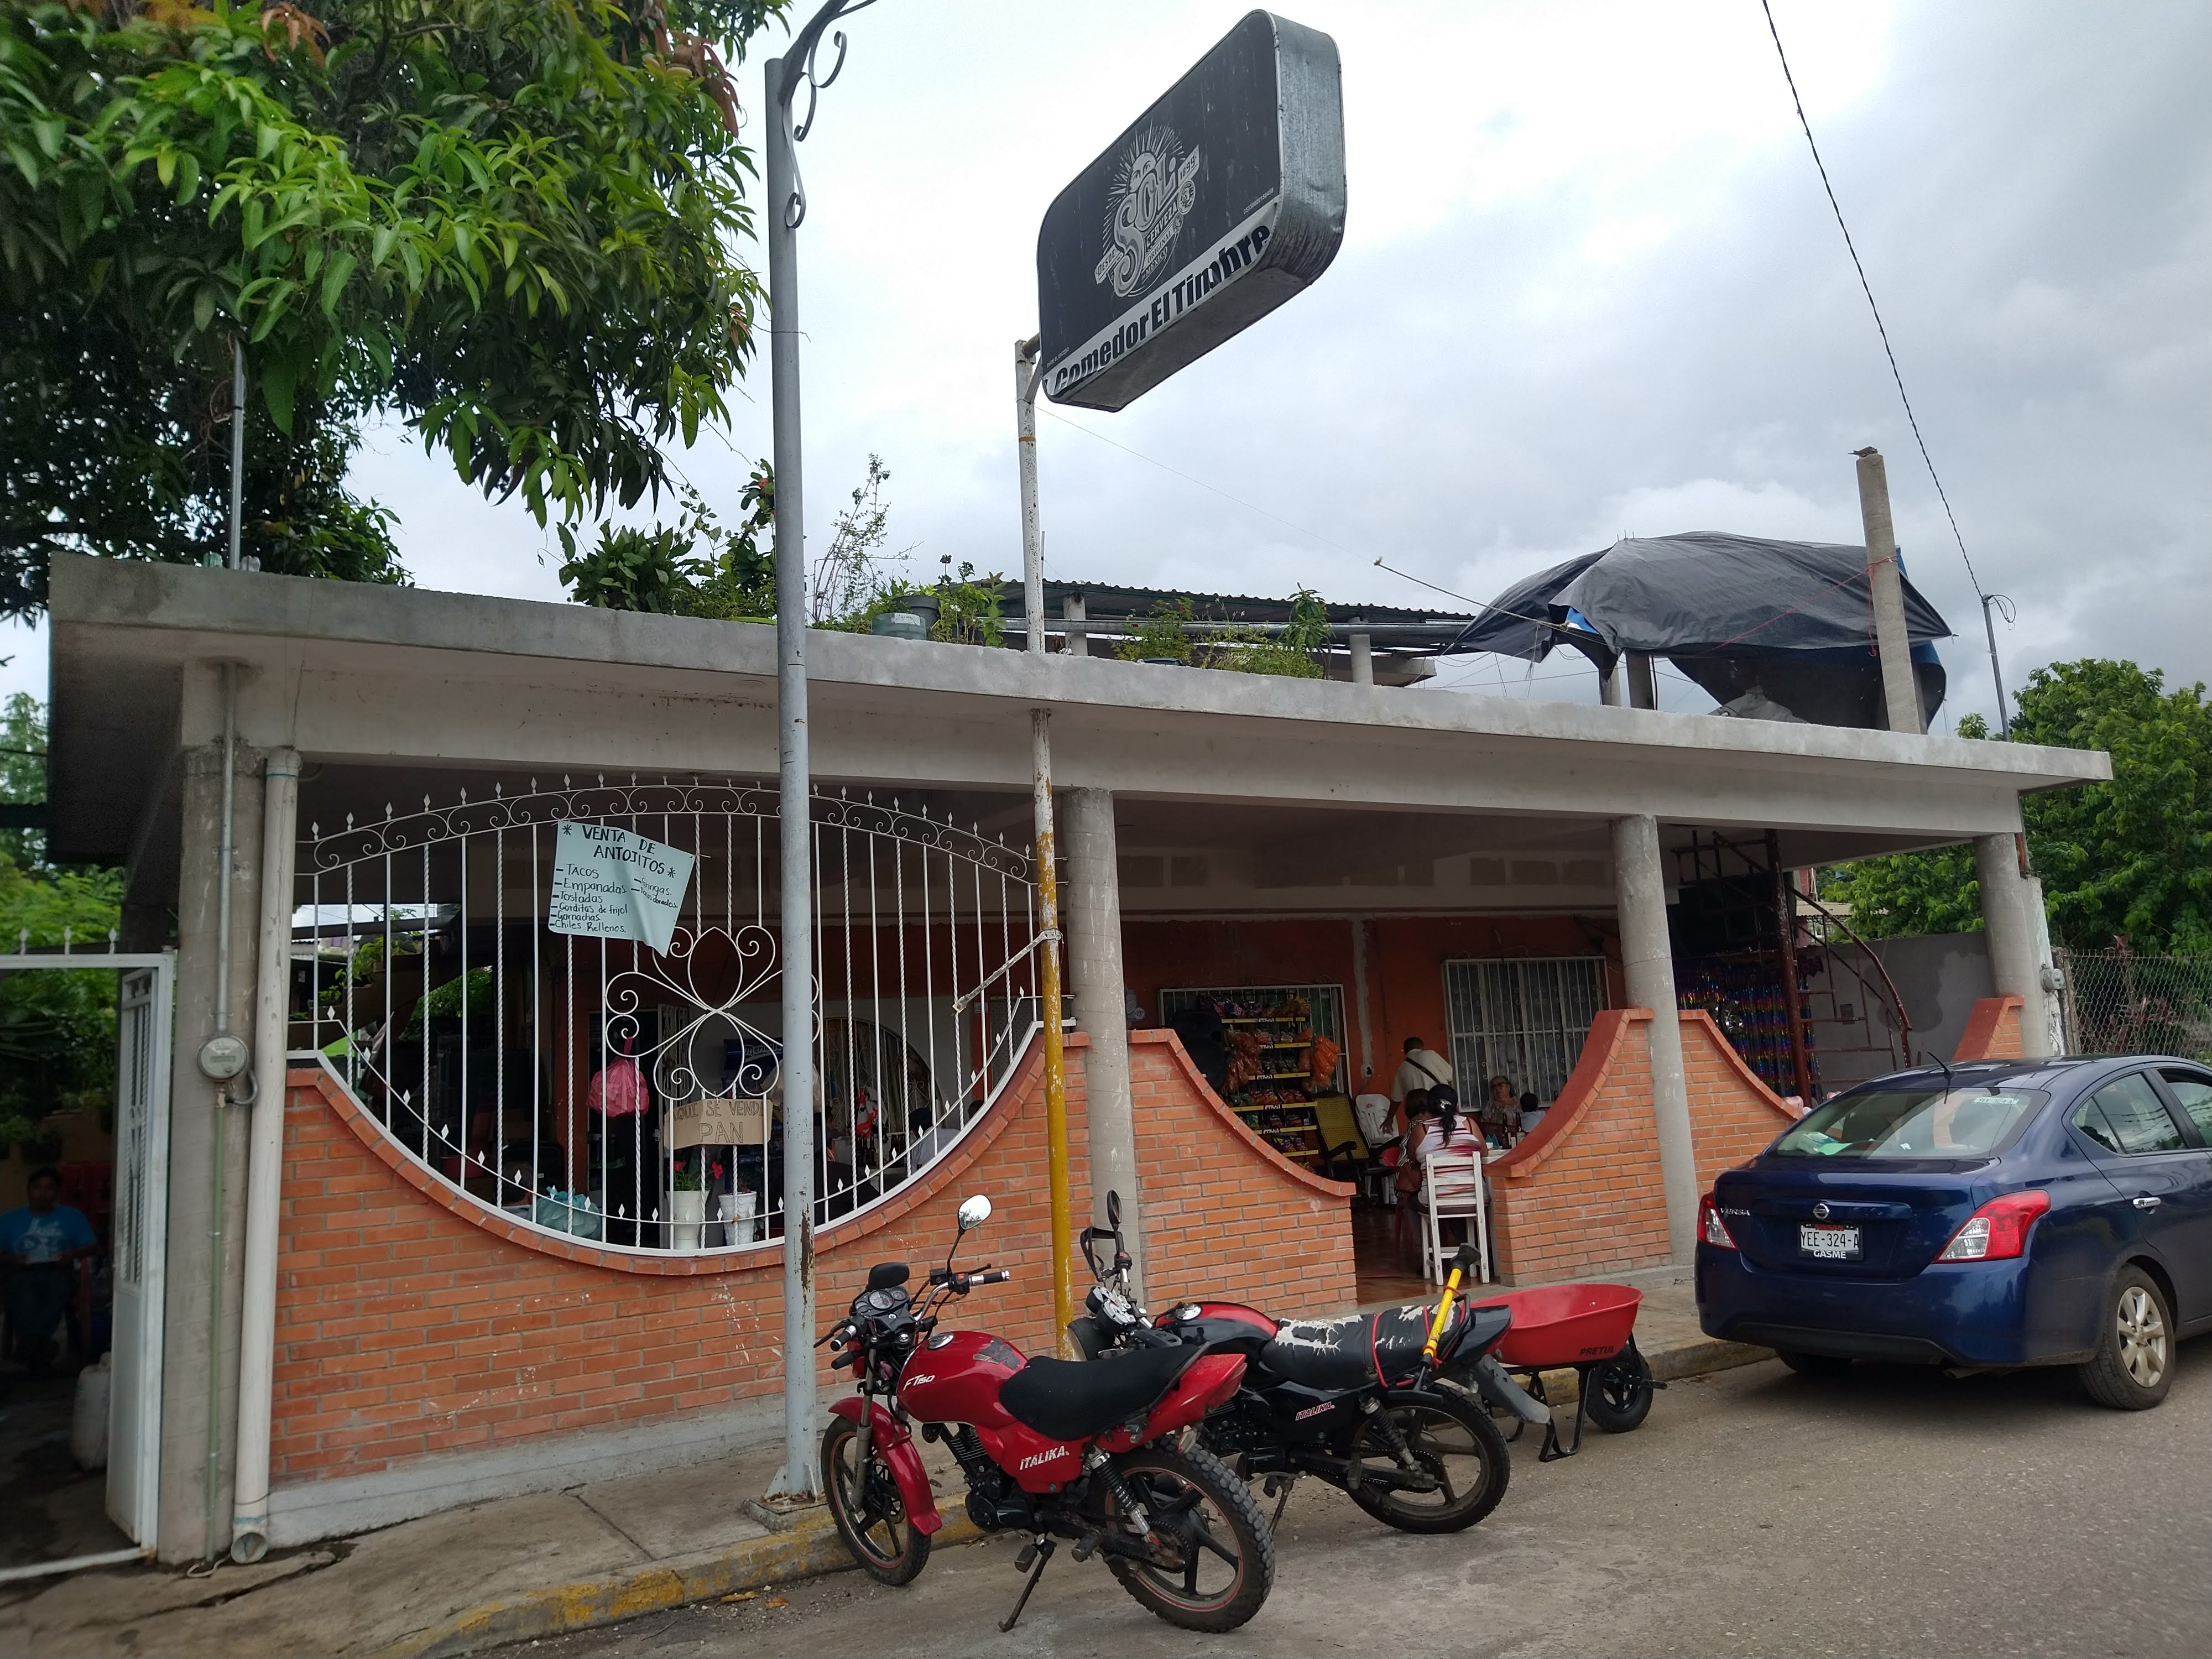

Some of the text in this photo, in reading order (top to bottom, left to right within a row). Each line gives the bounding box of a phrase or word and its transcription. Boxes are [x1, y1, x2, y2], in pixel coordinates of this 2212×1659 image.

[1180, 156, 1196, 180] 1899
[1146, 202, 1178, 248] CERVEZA
[1147, 231, 1172, 263] ORIGINAL
[1097, 249, 1115, 276] DESDE
[1054, 226, 1270, 391] Comedor El Timbre
[582, 825, 656, 854] VENTA DE
[593, 845, 665, 875] ANTOJITOS
[566, 863, 599, 879] TACOS
[560, 890, 603, 903] Tostadas
[559, 902, 628, 916] Gorditas de frijol
[555, 920, 582, 929] Chiles
[706, 1100, 722, 1117] SE
[698, 1121, 743, 1144] PAN
[1720, 1207, 1750, 1216] VERSA
[1801, 1231, 1859, 1248] YEE-324-A
[1813, 1250, 1846, 1259] GASME
[1295, 1401, 1332, 1421] ITALIKA
[1019, 1446, 1065, 1470] ITALIKA
